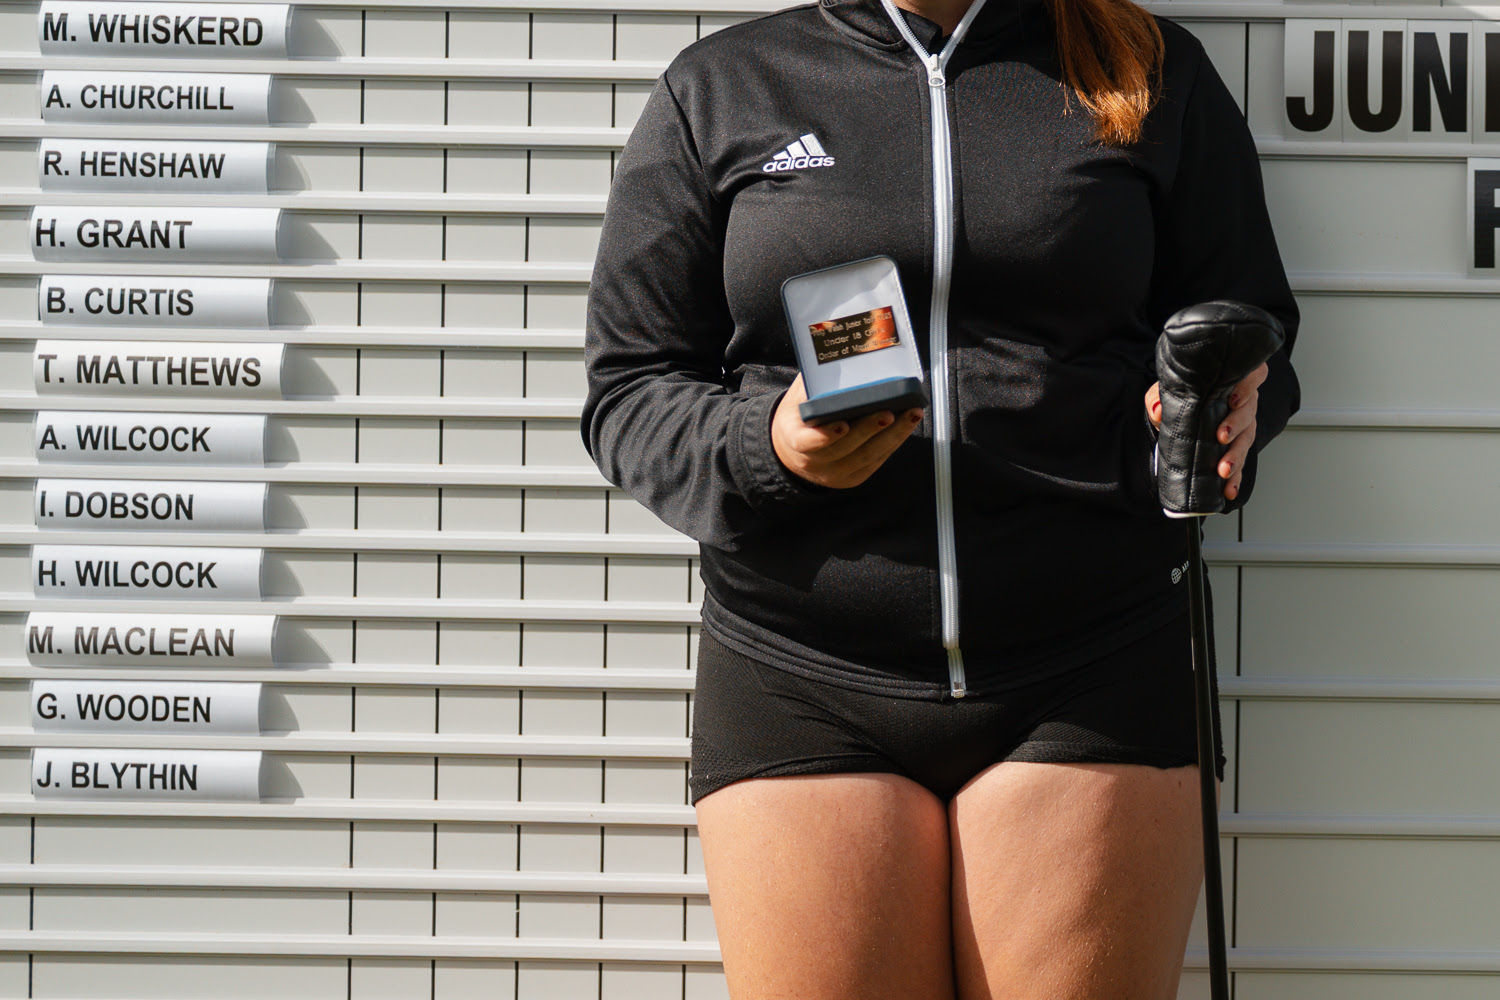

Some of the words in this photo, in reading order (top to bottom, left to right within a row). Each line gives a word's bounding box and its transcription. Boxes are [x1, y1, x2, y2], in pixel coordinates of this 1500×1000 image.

[43, 12, 77, 42] M.
[88, 13, 263, 47] WHISKERD
[45, 84, 71, 109] A.
[80, 85, 234, 111] CHURCHILL
[43, 151, 70, 176] R.
[80, 151, 226, 179] HENSHAW
[762, 155, 836, 173] adidas
[35, 218, 66, 248] H.
[76, 219, 193, 250] GRANT
[46, 287, 75, 314] B.
[84, 288, 194, 317] CURTIS
[38, 355, 65, 384] T.
[76, 356, 261, 388] MATTHEWS
[39, 425, 67, 450] A.
[76, 425, 211, 453] WILCOCK
[40, 491, 54, 518] I.
[65, 491, 194, 521] DOBSON
[38, 560, 66, 587] H.
[75, 560, 218, 589] WILCOCK
[28, 627, 63, 655] M.
[73, 627, 236, 657] MACLEAN
[36, 692, 66, 720] G.
[76, 693, 211, 724] WOODEN
[36, 761, 61, 788] J.
[71, 762, 198, 791] BLYTHIN
